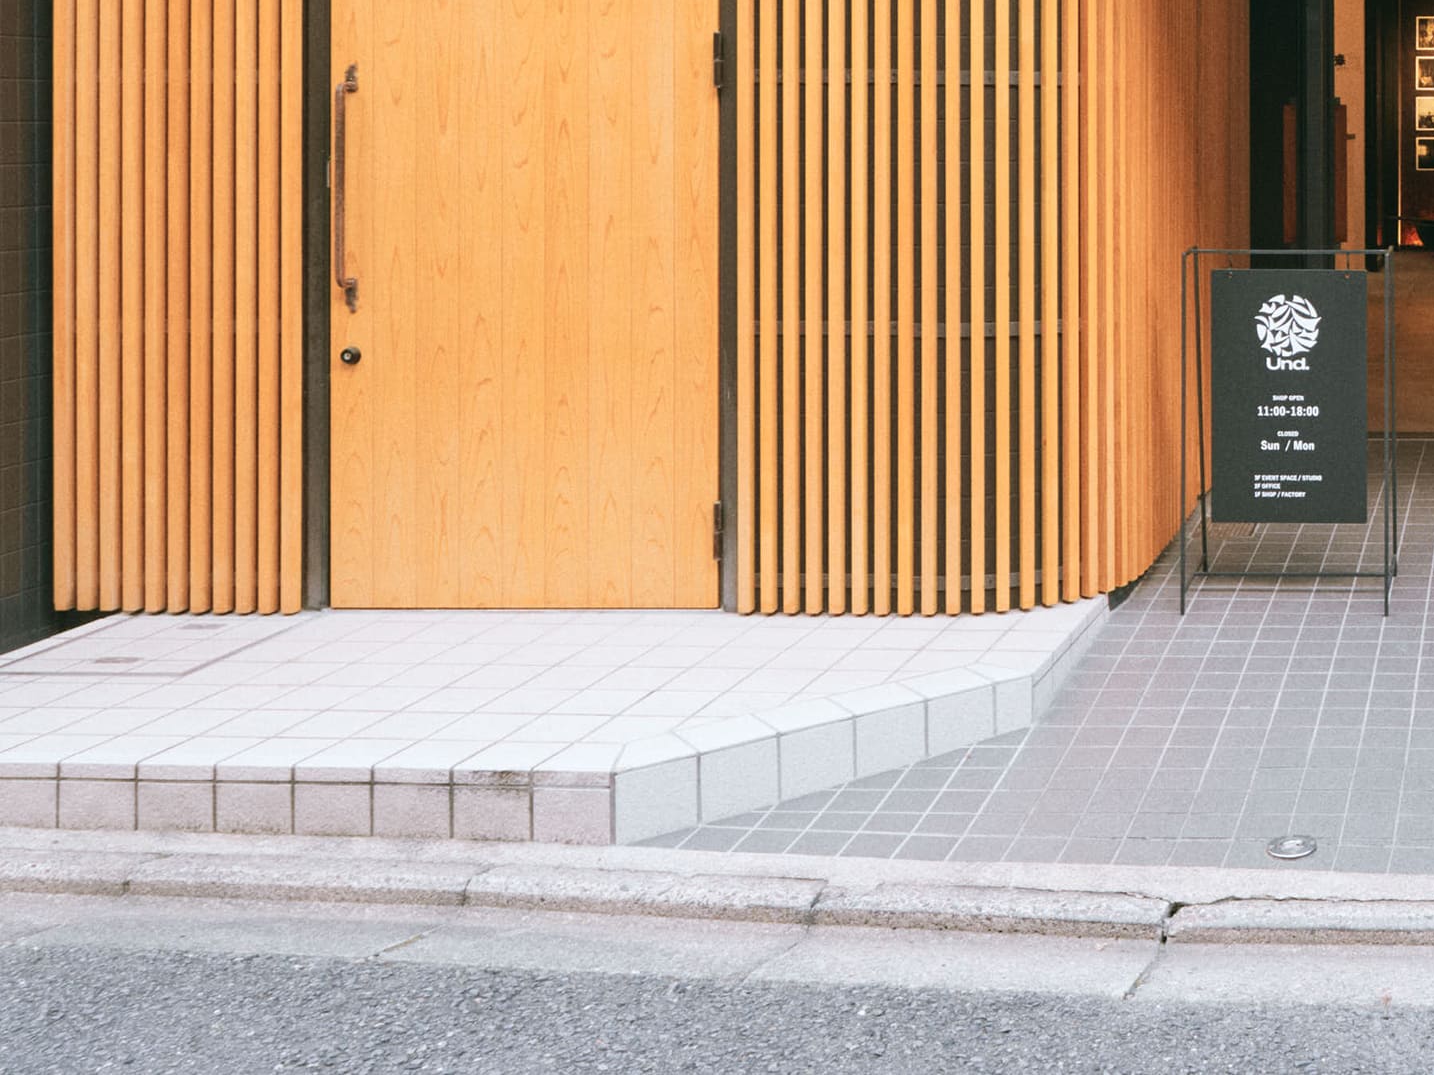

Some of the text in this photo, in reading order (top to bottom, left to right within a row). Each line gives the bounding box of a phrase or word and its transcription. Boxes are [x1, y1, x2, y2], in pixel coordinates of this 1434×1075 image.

[1266, 357, 1310, 371] Und.
[1257, 405, 1319, 416] 11:00-18:00
[1260, 439, 1280, 450] Sun
[1293, 440, 1315, 450] Mon
